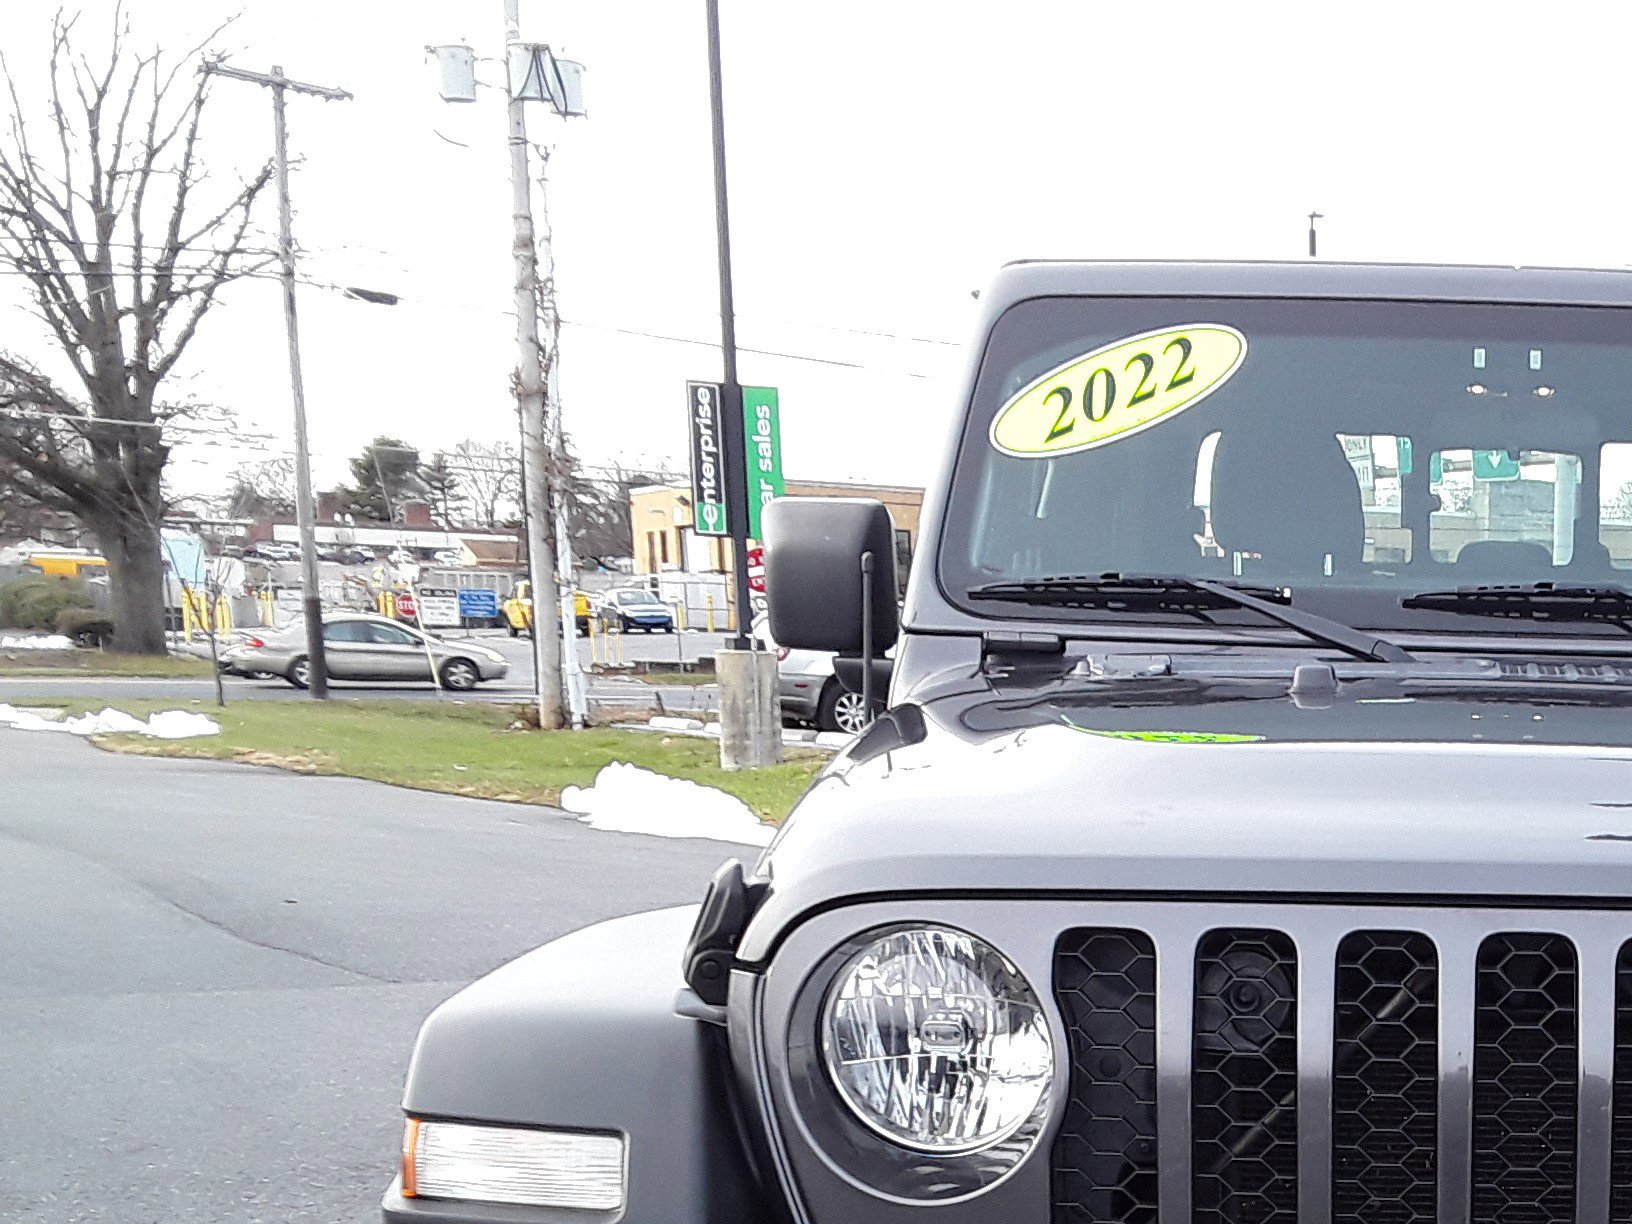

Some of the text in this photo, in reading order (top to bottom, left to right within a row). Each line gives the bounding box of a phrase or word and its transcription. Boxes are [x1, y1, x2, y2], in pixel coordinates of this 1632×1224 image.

[752, 404, 773, 473] sales
[1042, 337, 1196, 443] 2022
[696, 387, 718, 528] enterprise
